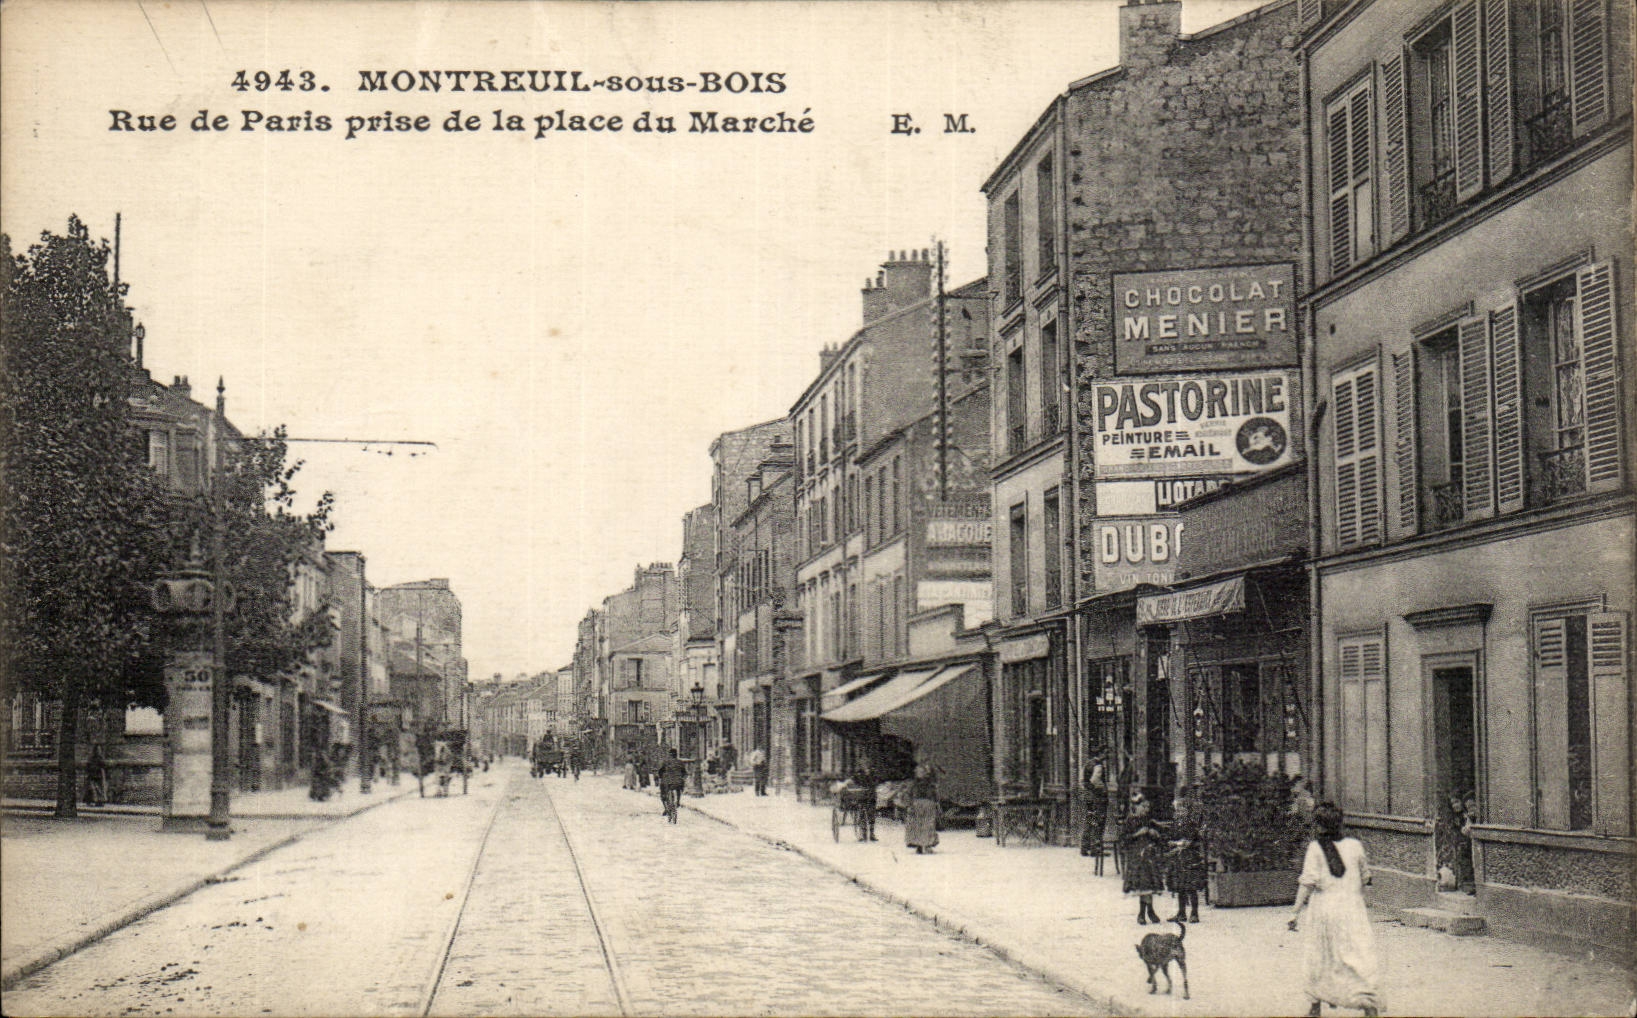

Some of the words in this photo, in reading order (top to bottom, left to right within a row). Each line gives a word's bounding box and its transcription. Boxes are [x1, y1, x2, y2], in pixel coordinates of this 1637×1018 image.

[1124, 279, 1284, 308] CHOCOLAT
[1124, 308, 1287, 340] MENIER
[1097, 377, 1285, 432] PASTORINE
